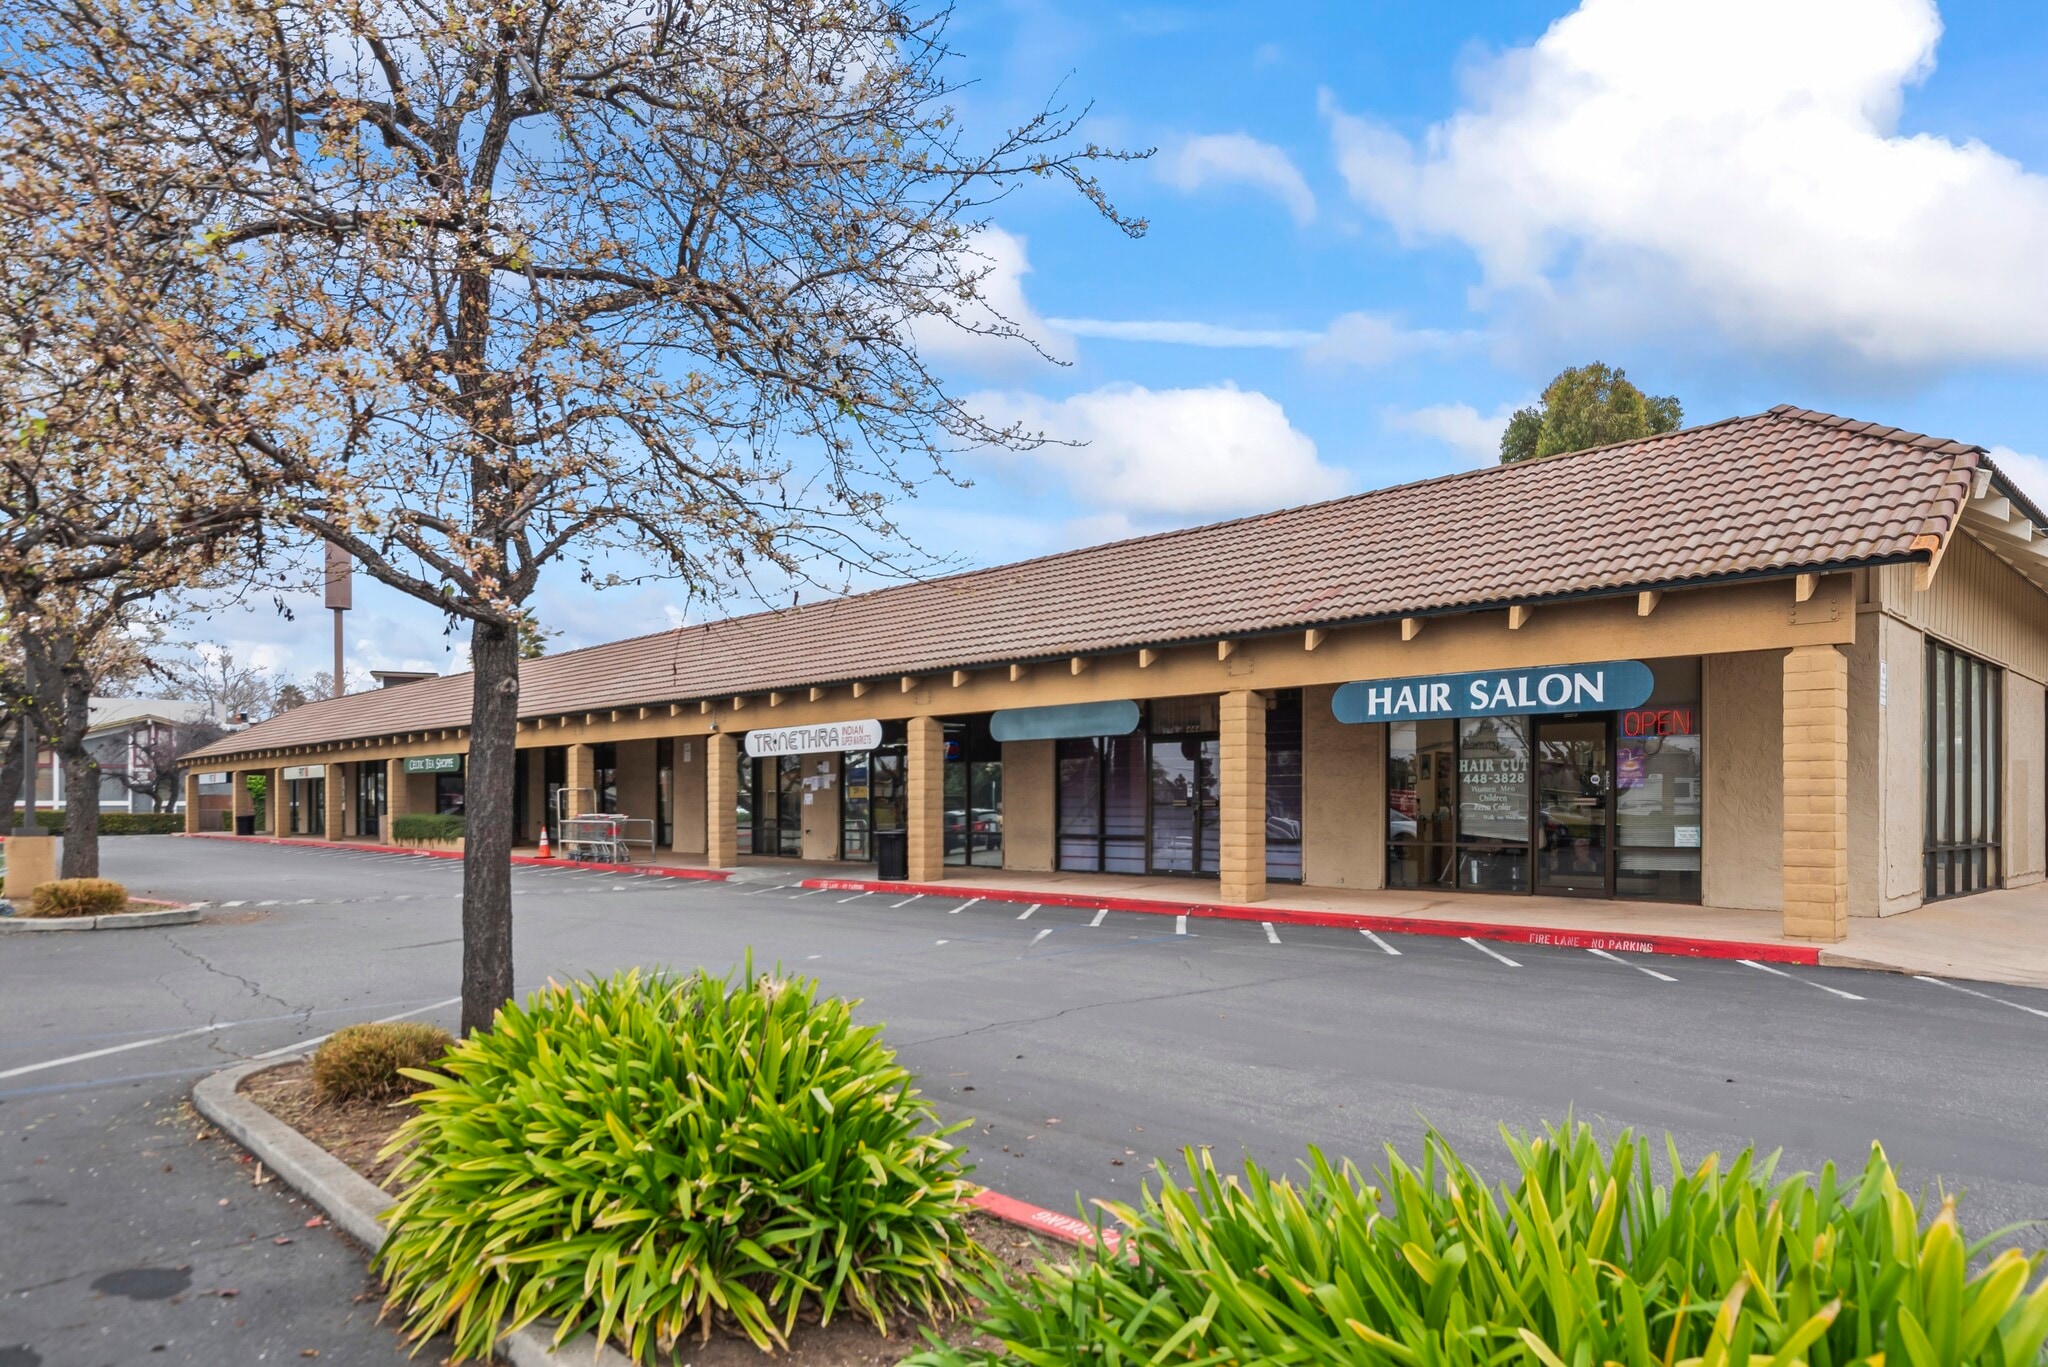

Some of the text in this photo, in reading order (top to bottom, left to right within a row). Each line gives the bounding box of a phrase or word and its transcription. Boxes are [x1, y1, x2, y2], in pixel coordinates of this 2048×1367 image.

[1368, 671, 1604, 716] HAIR SALON
[1624, 710, 1691, 736] OPEN
[841, 725, 864, 736] INDIAN
[1459, 758, 1529, 773] HAIR CUT
[1463, 773, 1525, 784] 448-3828
[1471, 785, 1497, 793] Women
[1478, 793, 1508, 802] Children
[1492, 803, 1512, 811] Color
[1529, 933, 1551, 945] FIRE
[1554, 935, 1580, 947] LANE
[1591, 938, 1604, 949] NO
[1608, 940, 1654, 953] PARKING
